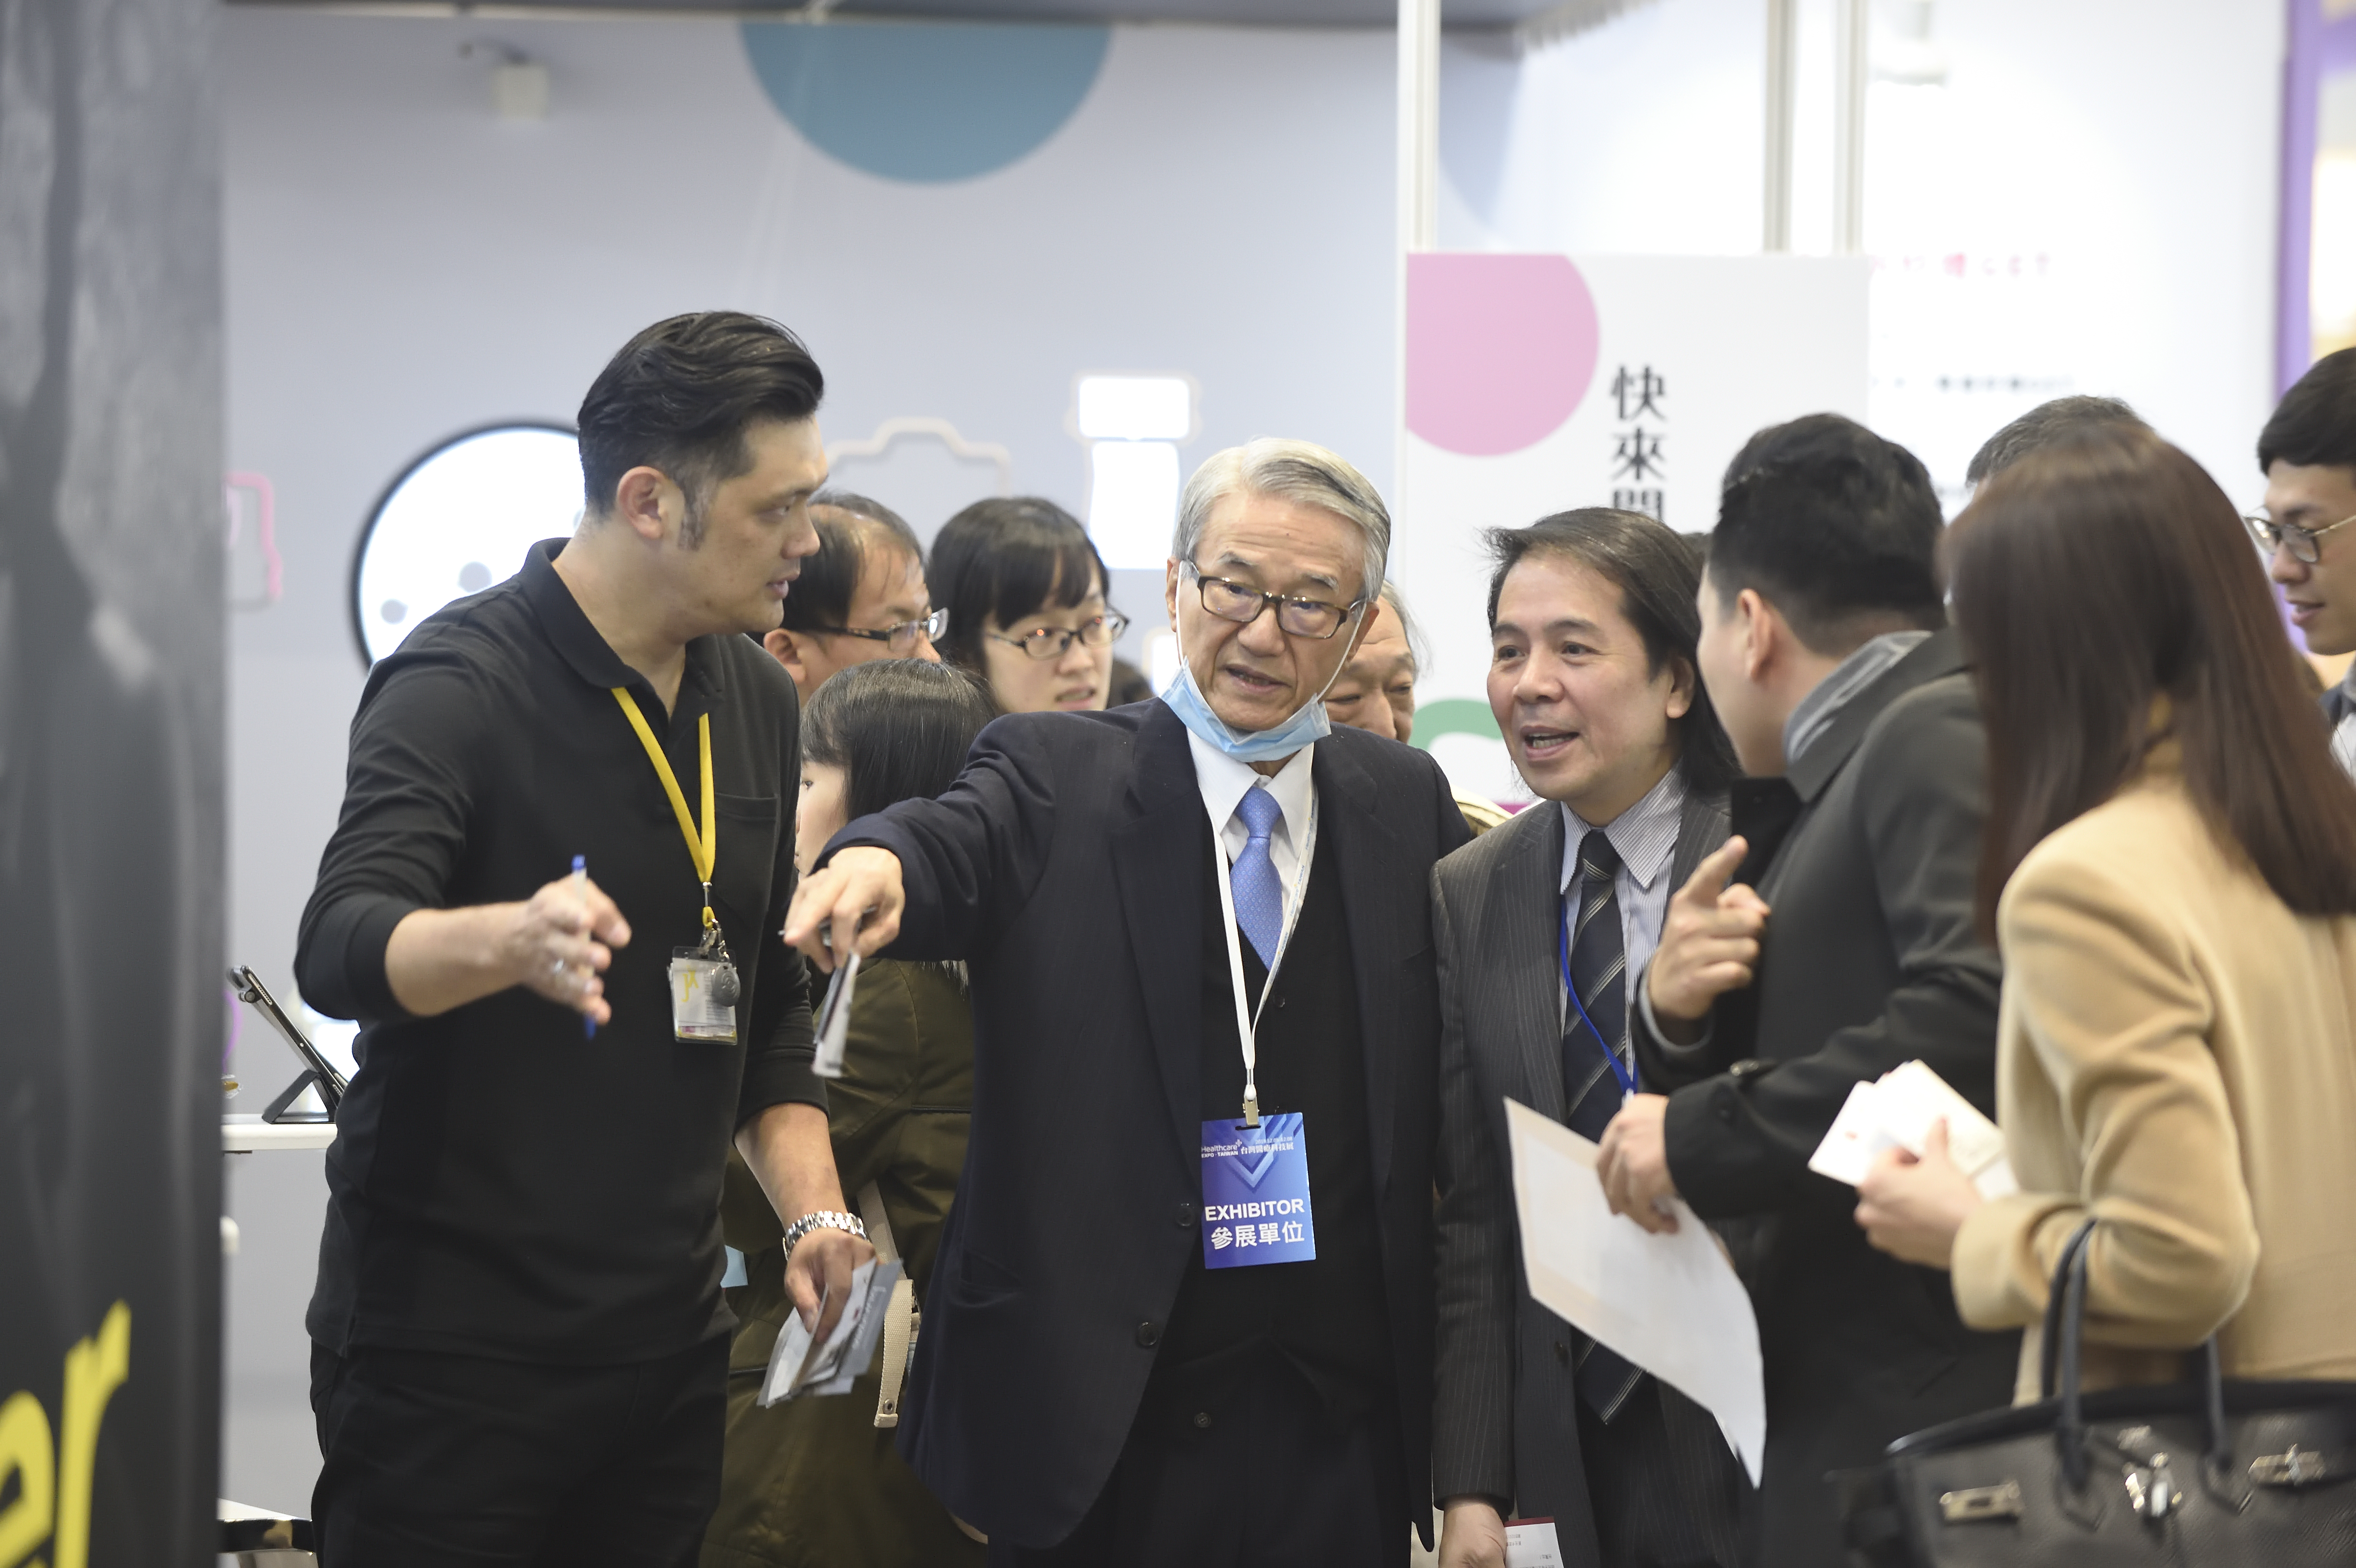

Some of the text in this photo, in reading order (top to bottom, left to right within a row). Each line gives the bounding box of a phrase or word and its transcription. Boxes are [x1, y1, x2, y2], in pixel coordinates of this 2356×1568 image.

[1204, 1198, 1305, 1221] EXHIBITOR
[1211, 1220, 1305, 1250] 參展單位
